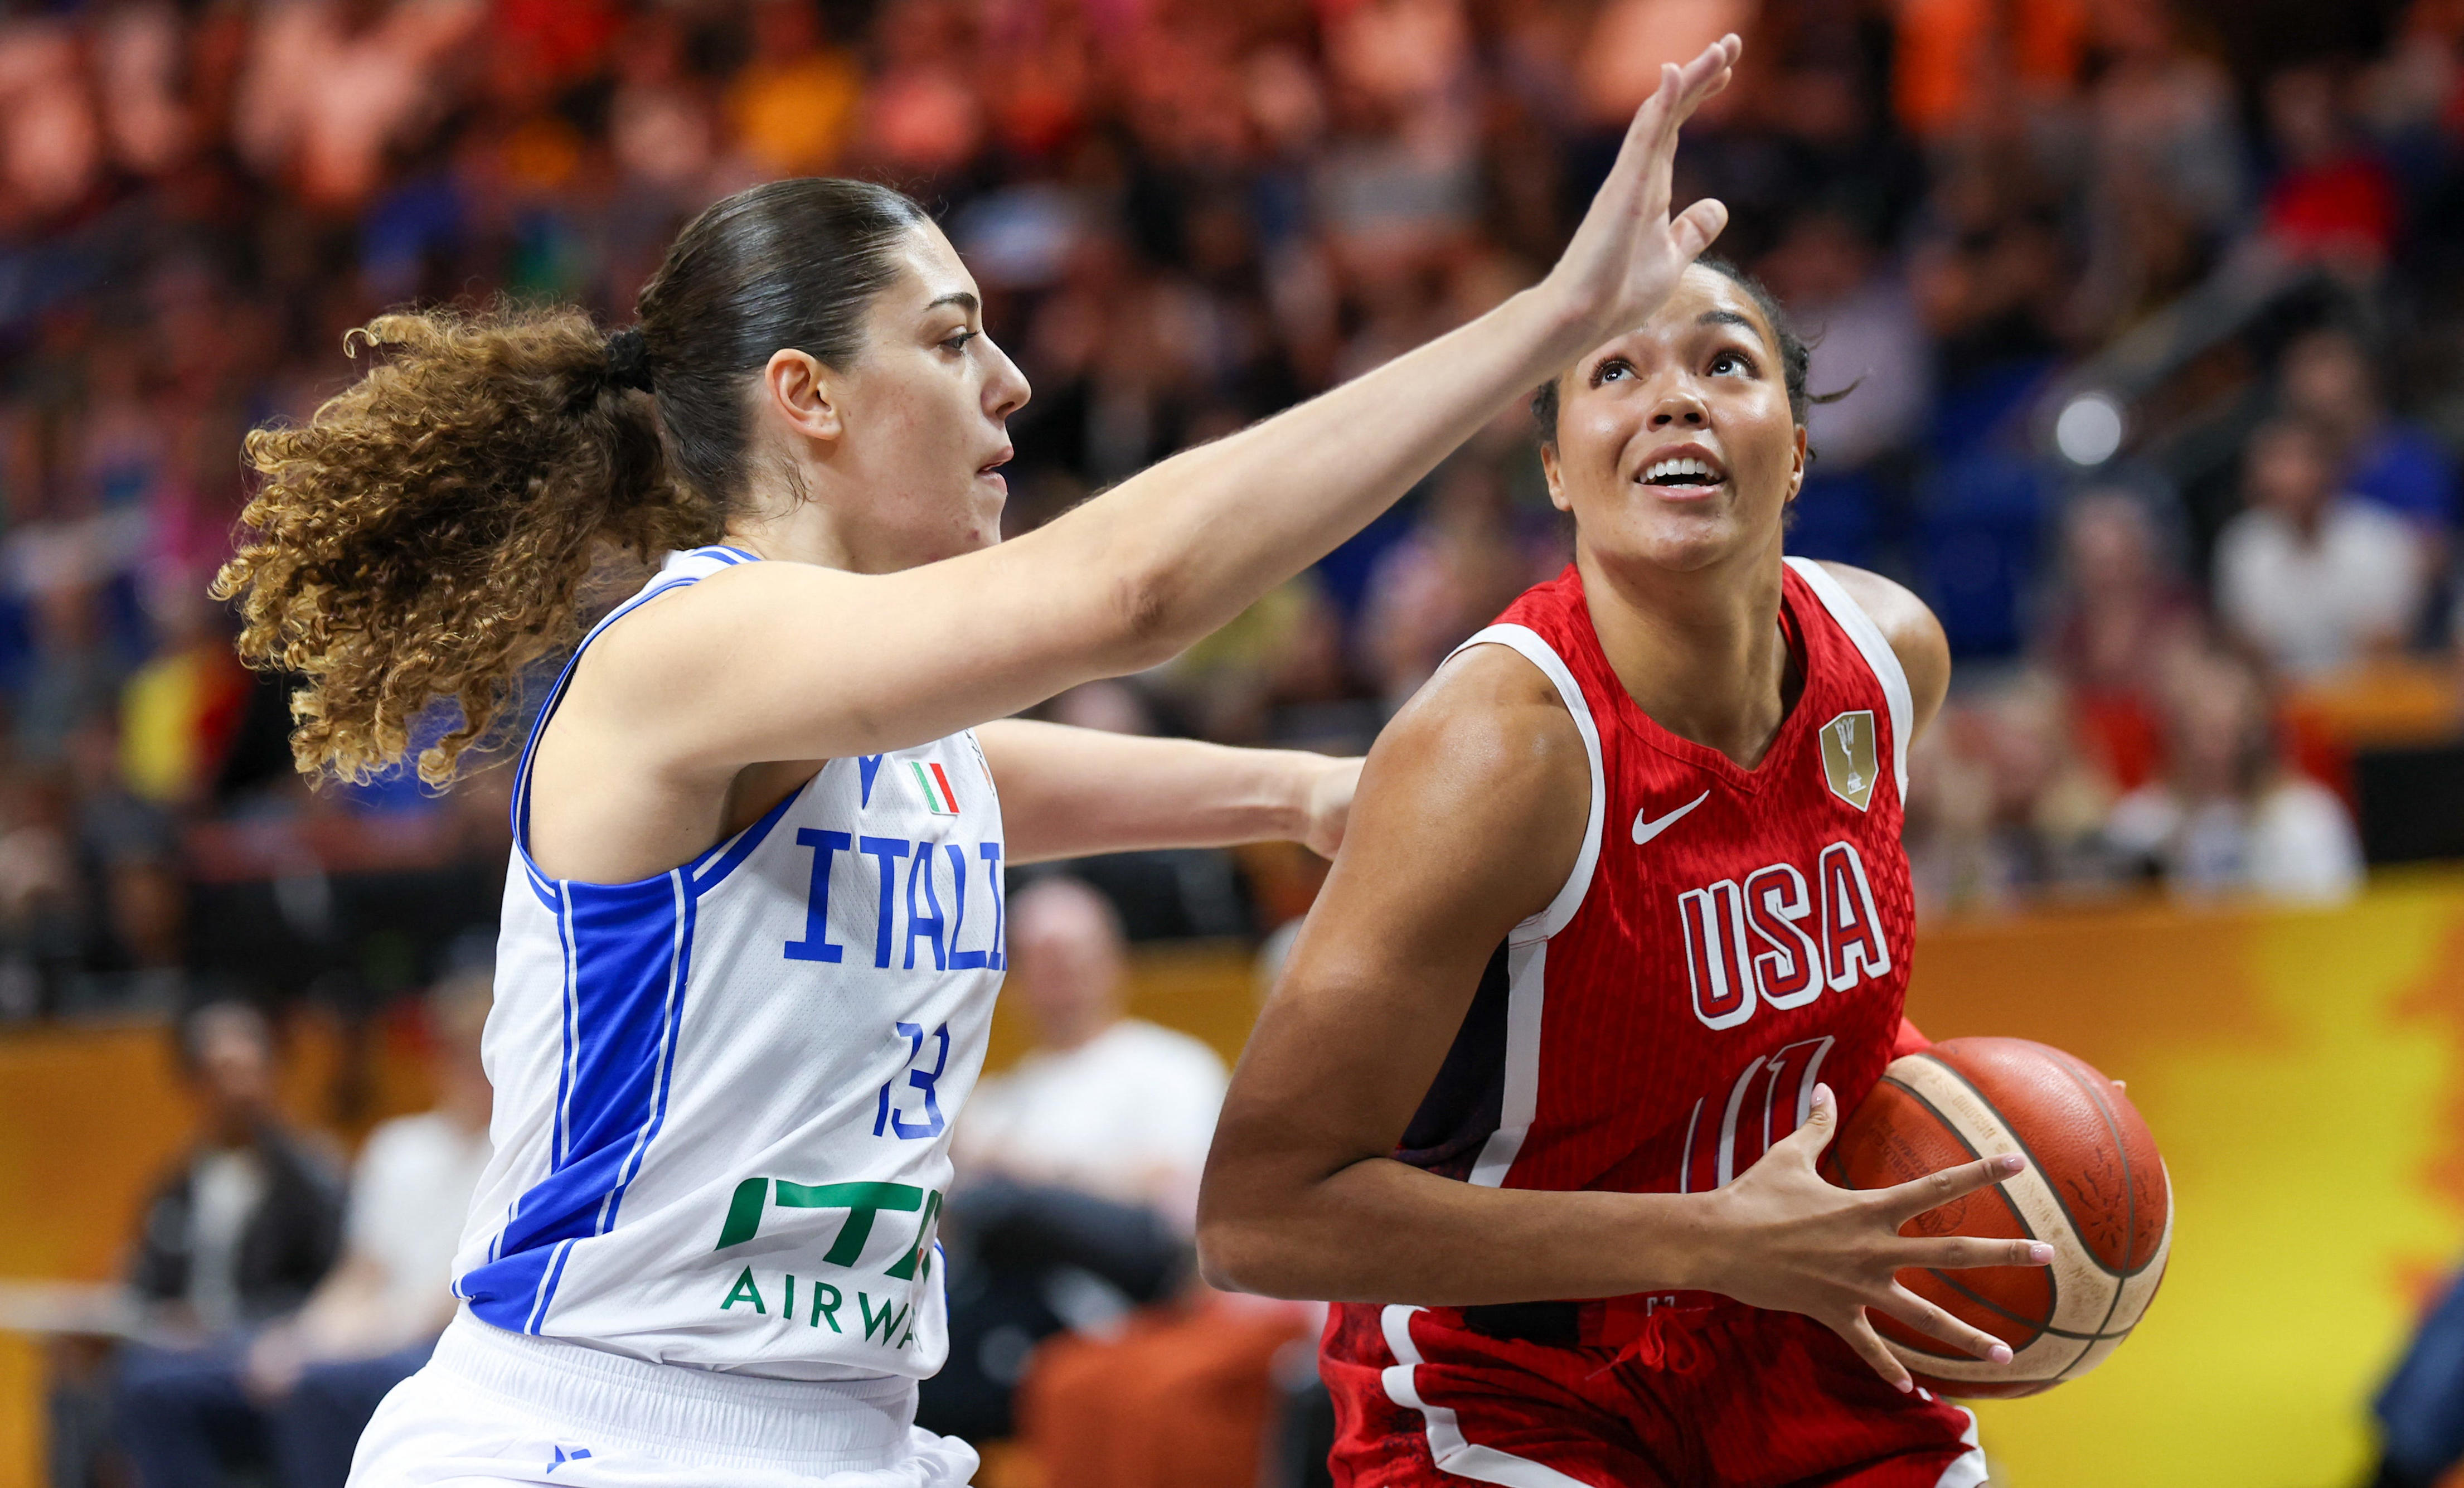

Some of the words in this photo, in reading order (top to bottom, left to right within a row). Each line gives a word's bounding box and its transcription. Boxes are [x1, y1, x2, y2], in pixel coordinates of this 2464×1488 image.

[784, 827, 1007, 971] ITALI
[1678, 841, 1891, 1030] USA
[872, 1021, 950, 1140] 13
